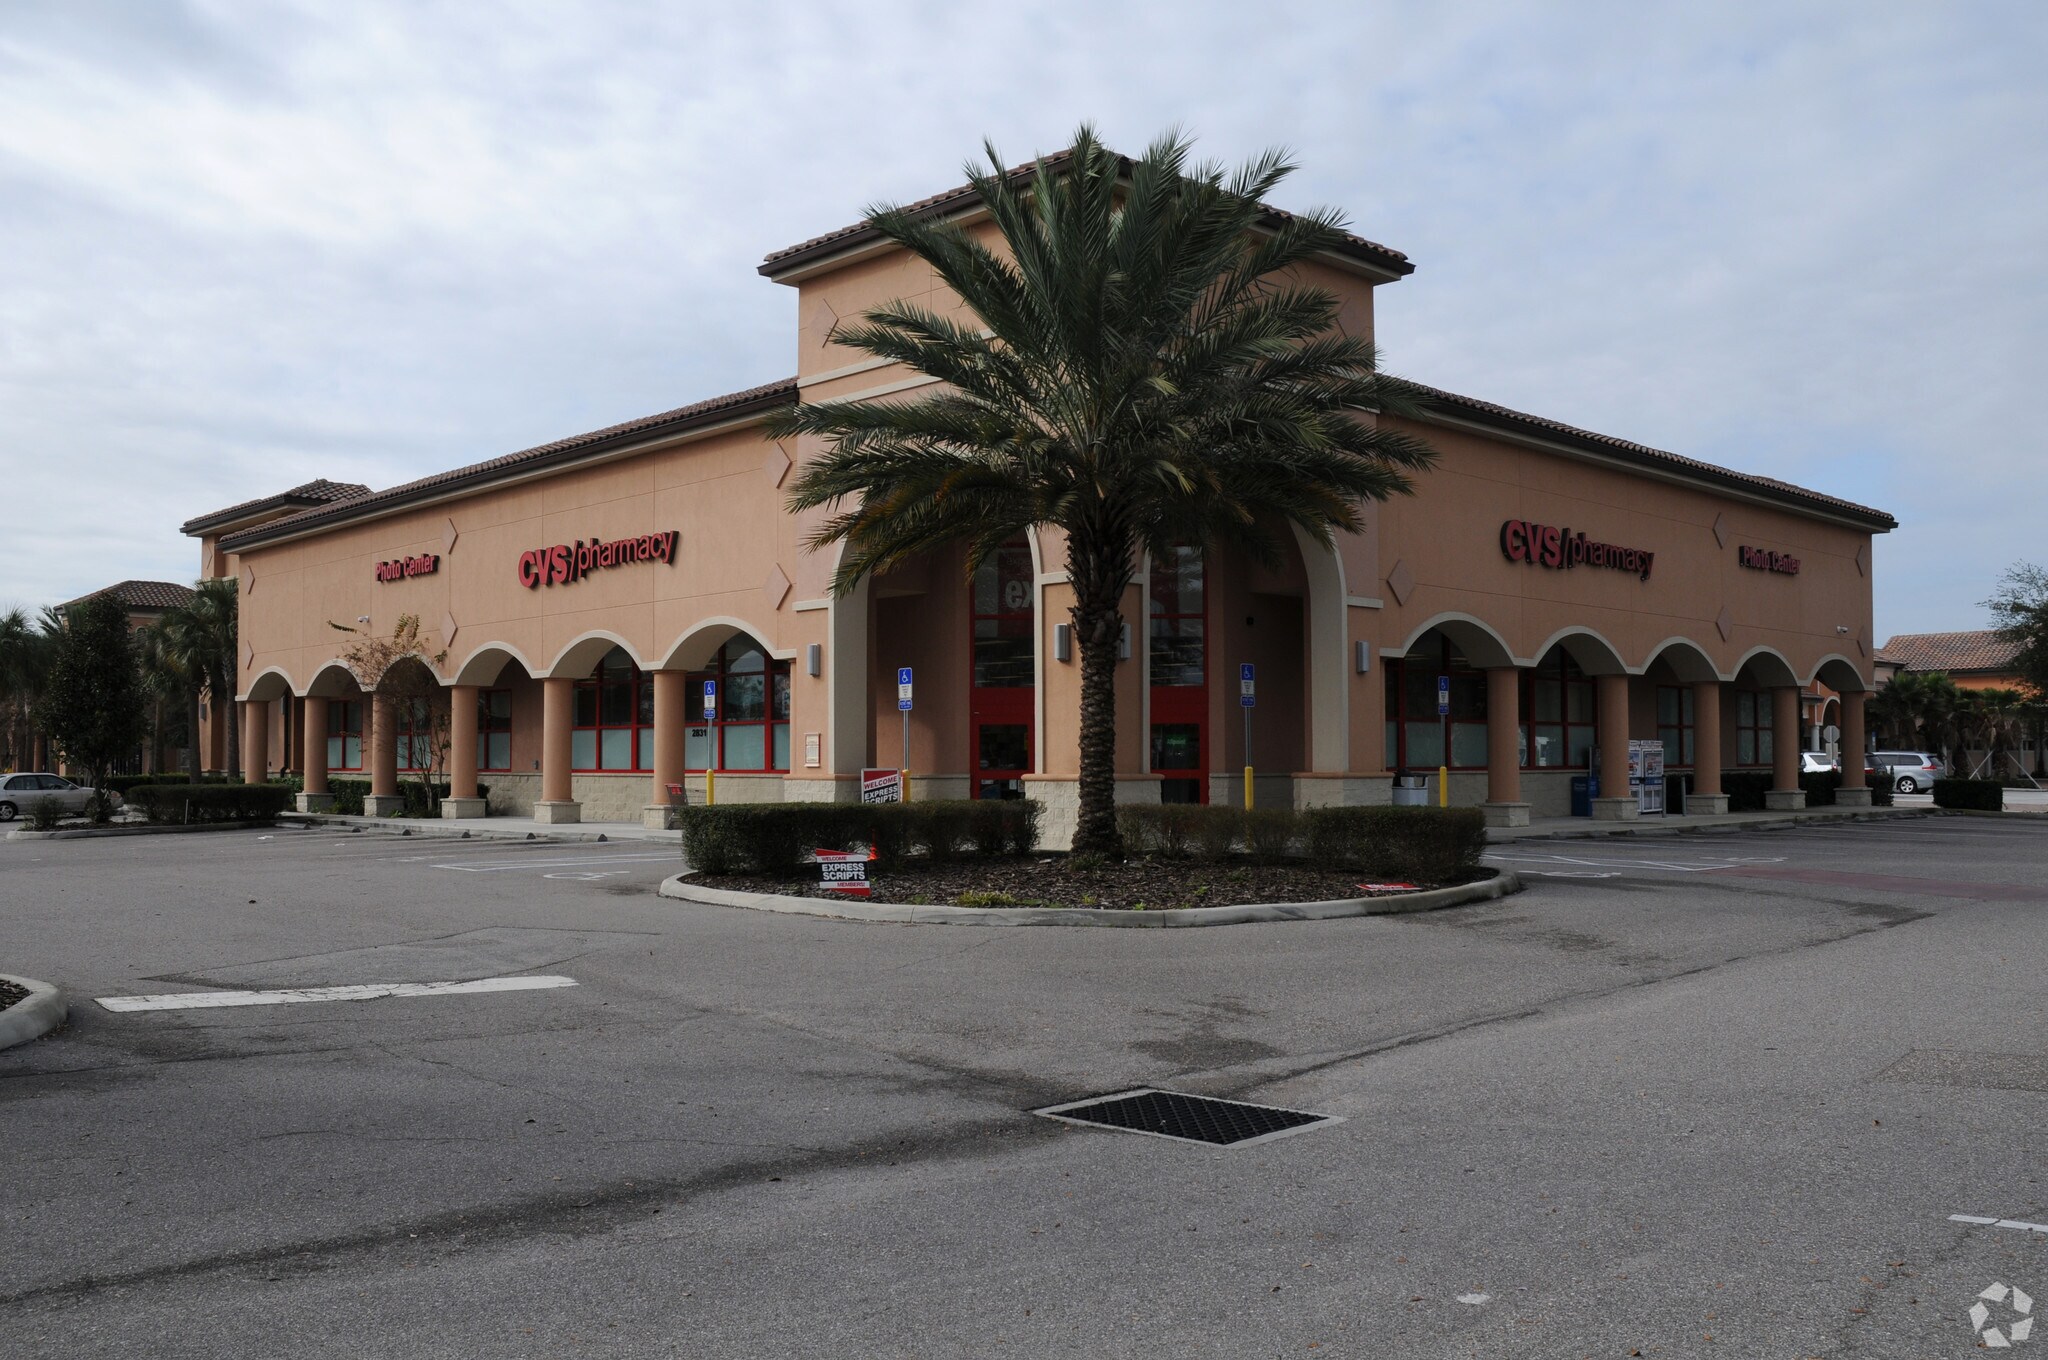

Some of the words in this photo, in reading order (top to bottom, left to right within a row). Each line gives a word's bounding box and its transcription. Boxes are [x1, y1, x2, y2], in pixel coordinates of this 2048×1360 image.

[1501, 519, 1655, 580] CVS/pharmacy
[375, 560, 401, 582] Photo
[404, 553, 437, 577] Center
[518, 530, 679, 589] CVS/pharmacy
[1741, 545, 1769, 569] Photo
[1771, 550, 1800, 575] Center
[692, 729, 707, 737] 2831
[864, 775, 897, 790] WELCOME
[864, 785, 898, 801] EXPRESS
[821, 863, 865, 872] EXPRESS
[823, 871, 866, 880] SCRIPTS
